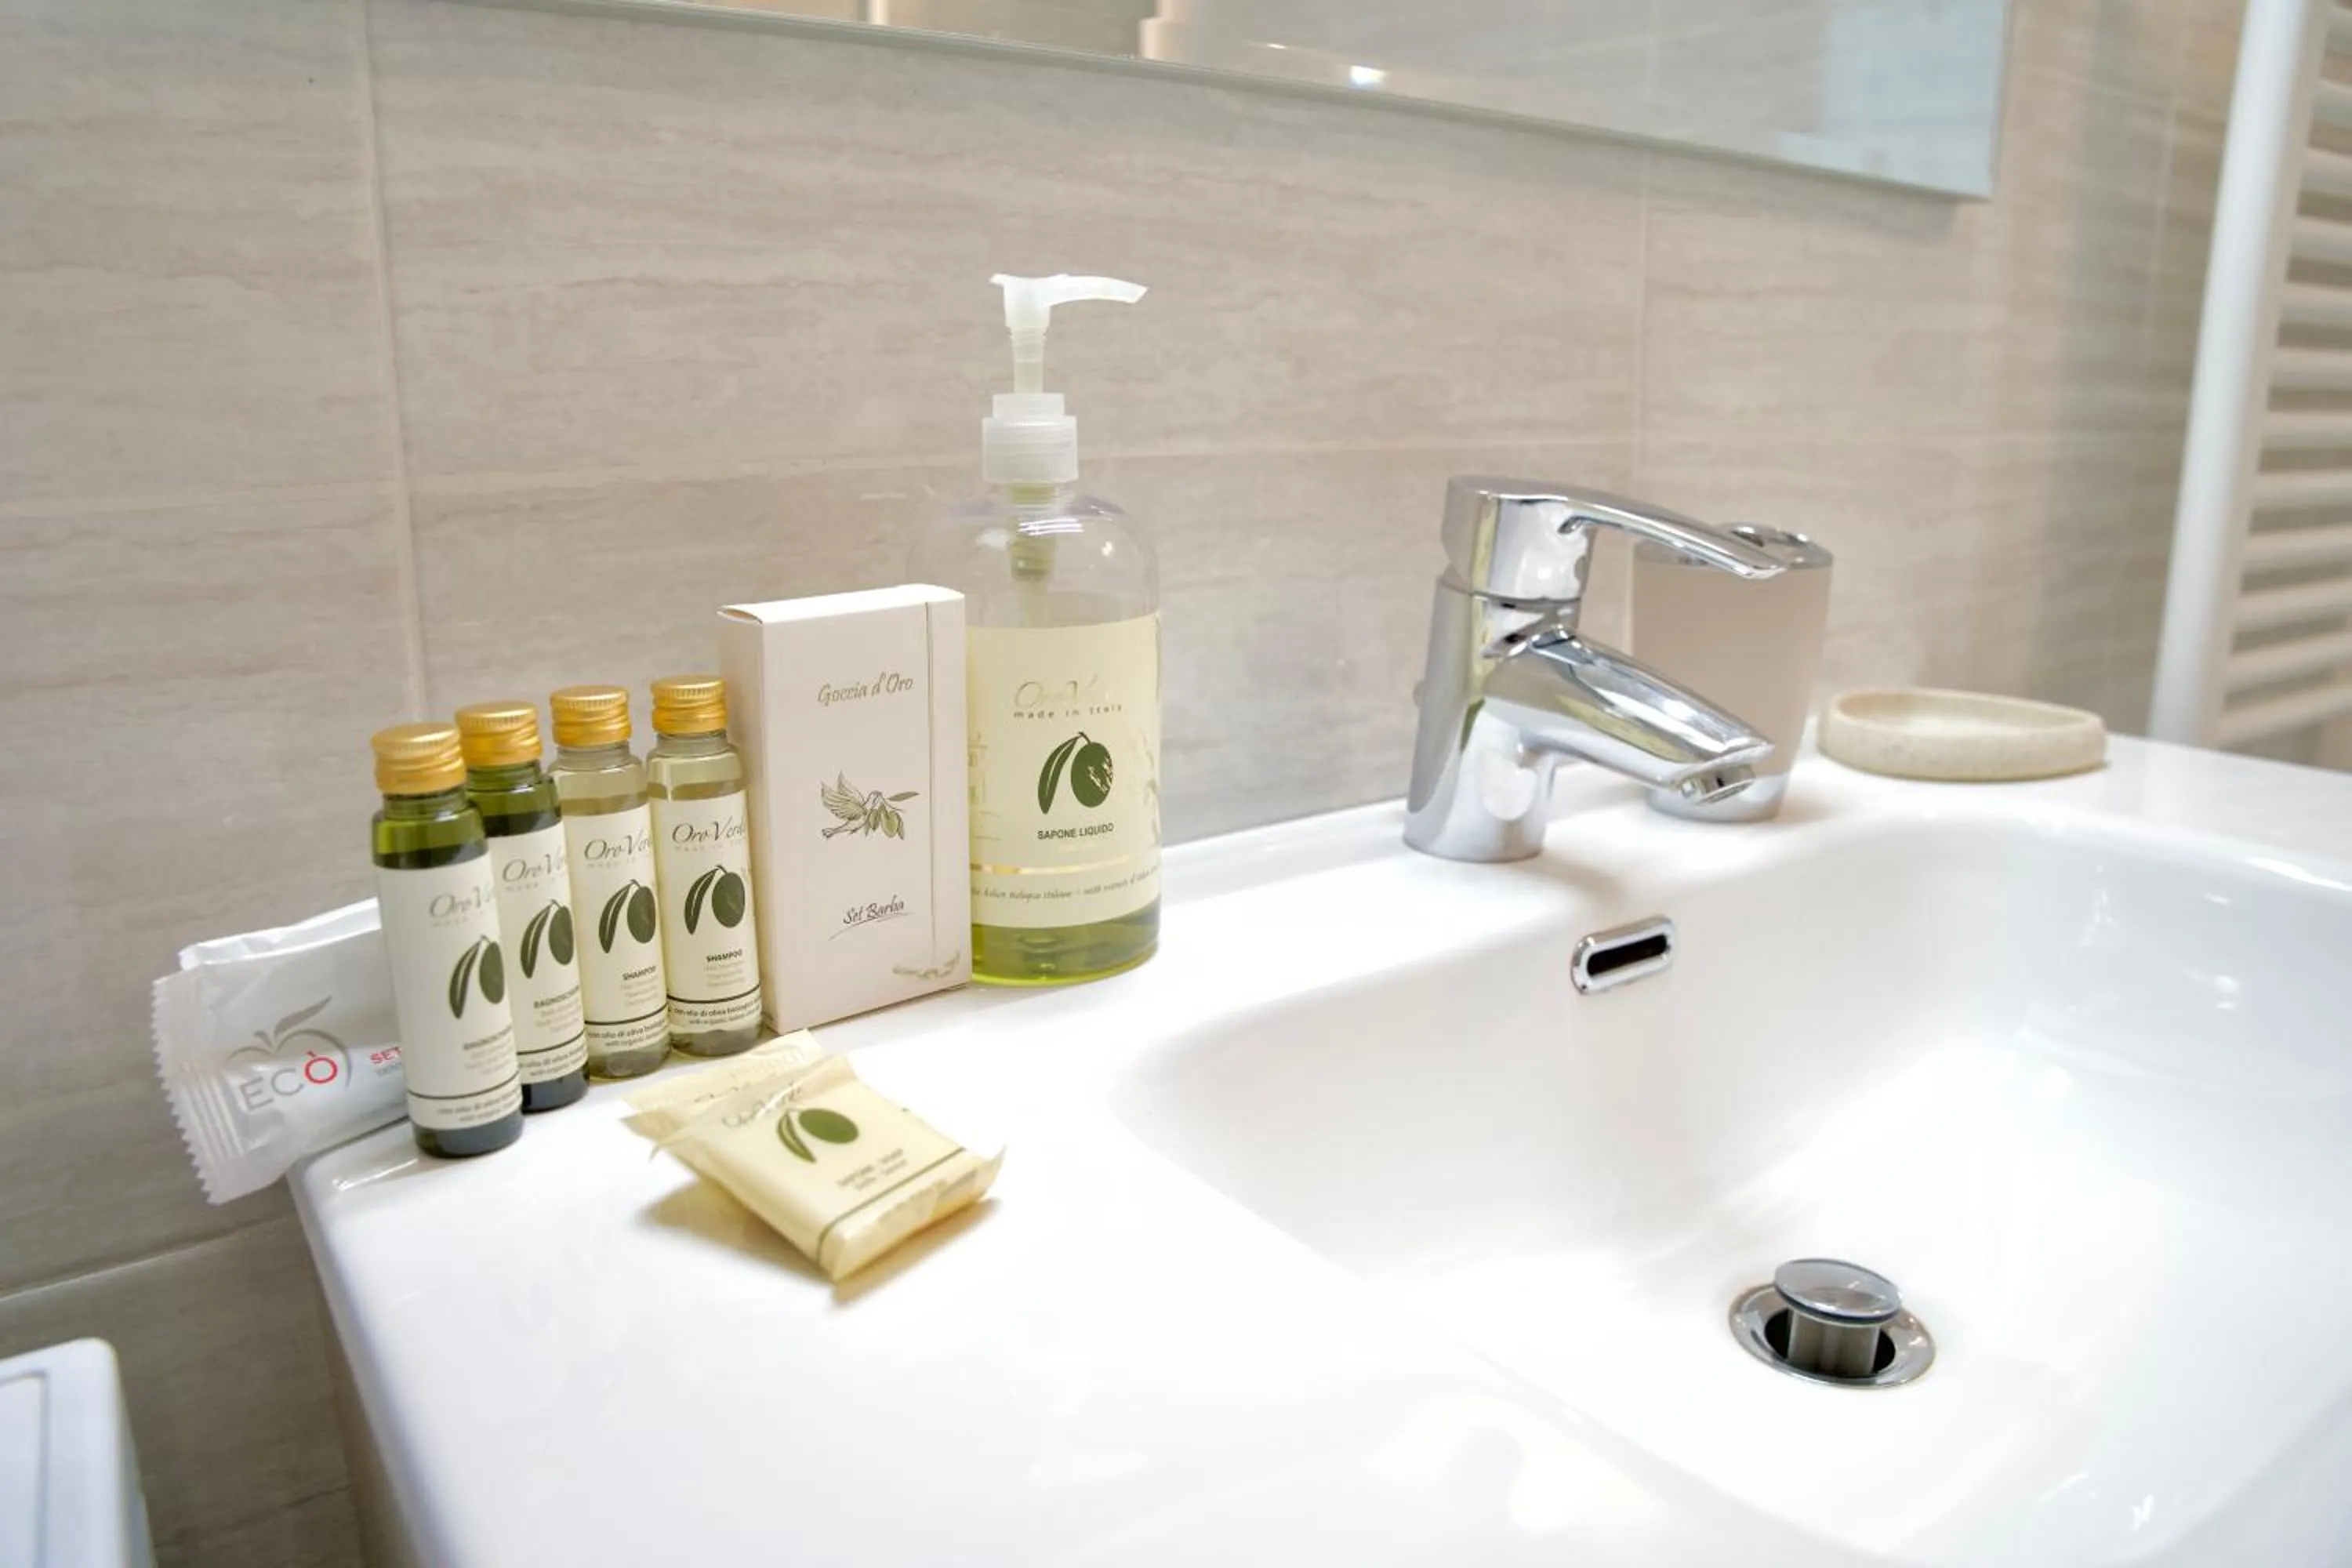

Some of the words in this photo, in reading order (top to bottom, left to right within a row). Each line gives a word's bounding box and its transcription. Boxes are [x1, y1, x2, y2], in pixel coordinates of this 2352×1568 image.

[817, 682, 867, 706] Goccia
[870, 670, 914, 697] d'Oro
[1036, 827, 1077, 841] SAPONE
[1078, 822, 1115, 838] LIQUIDO
[844, 902, 863, 925] Set
[865, 893, 906, 920] Barba
[705, 948, 744, 964] SHAMPOO
[240, 1049, 339, 1112] ECÒ
